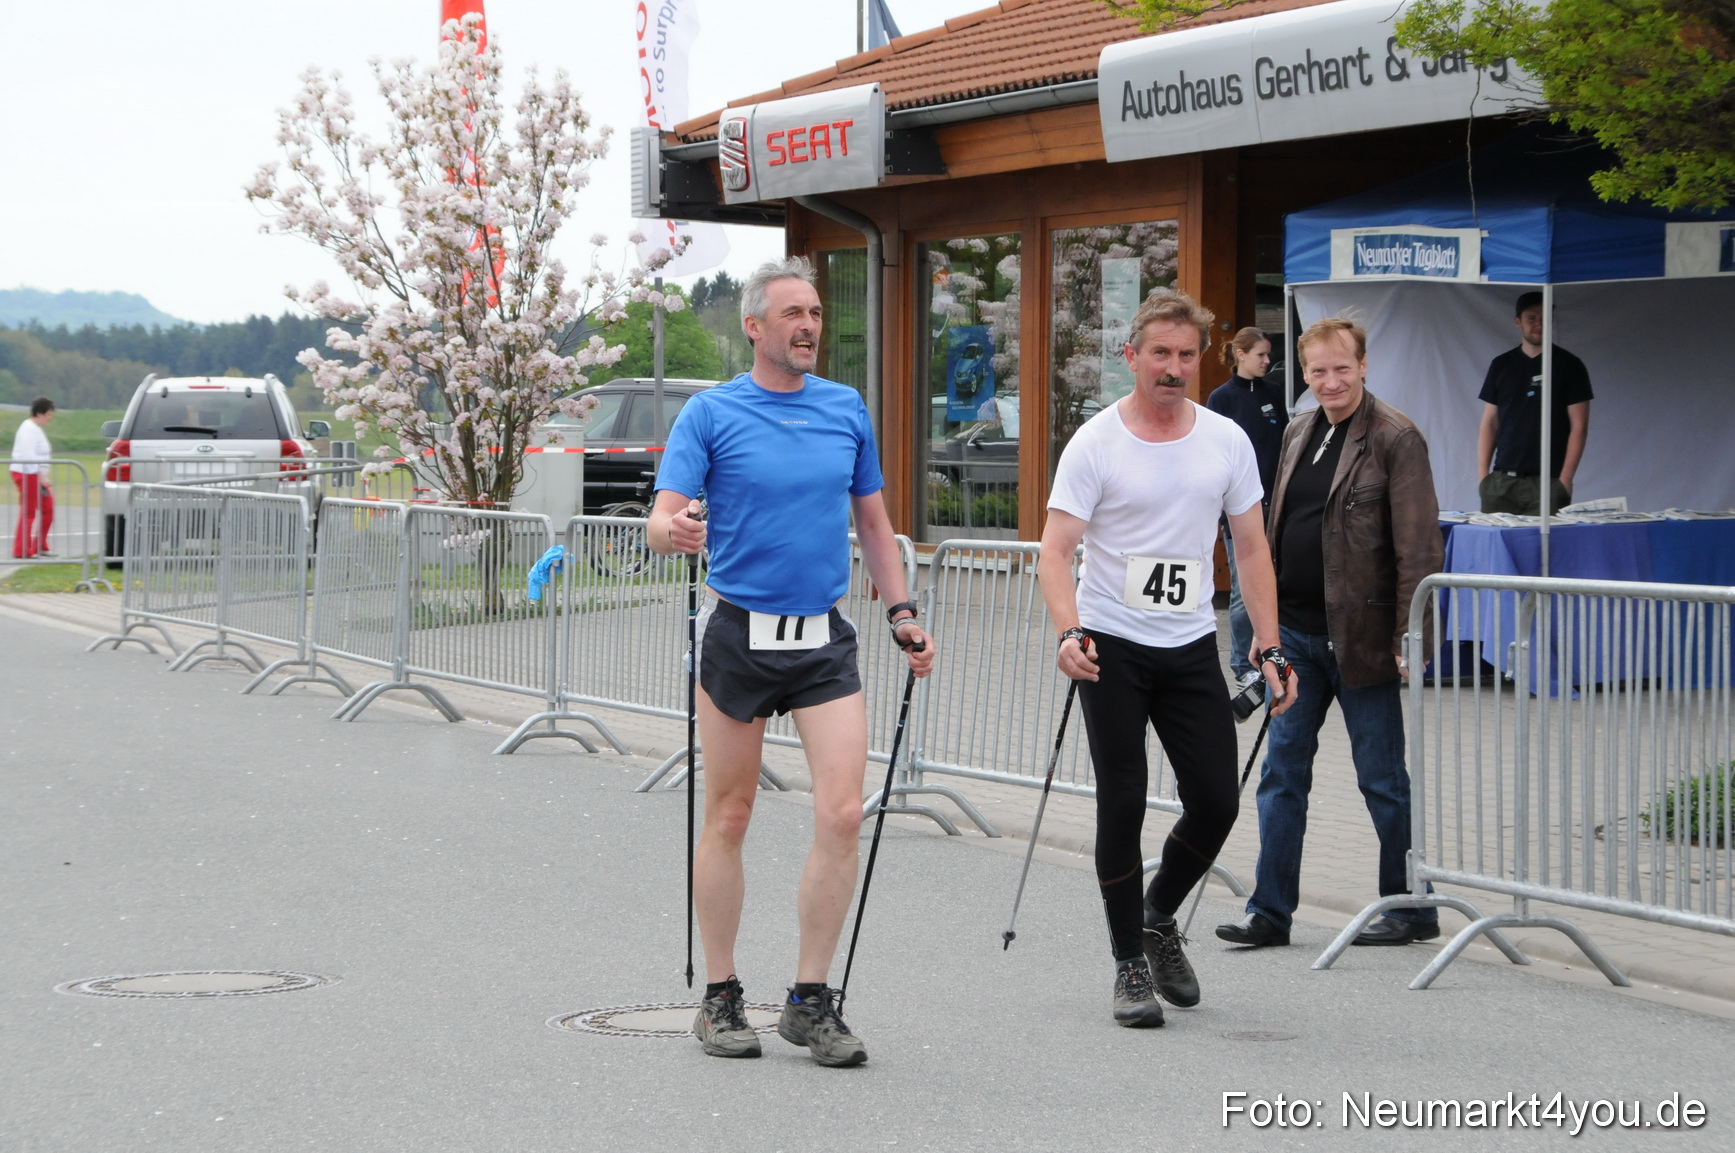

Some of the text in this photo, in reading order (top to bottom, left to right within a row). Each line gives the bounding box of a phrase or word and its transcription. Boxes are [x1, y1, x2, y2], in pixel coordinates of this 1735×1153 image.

[1121, 70, 1244, 122] Autohaus
[1255, 46, 1373, 100] Gerhart
[1385, 36, 1410, 82] &
[766, 119, 854, 166] SEAT
[1412, 242, 1456, 271] Tagblatt
[1142, 563, 1187, 606] 45
